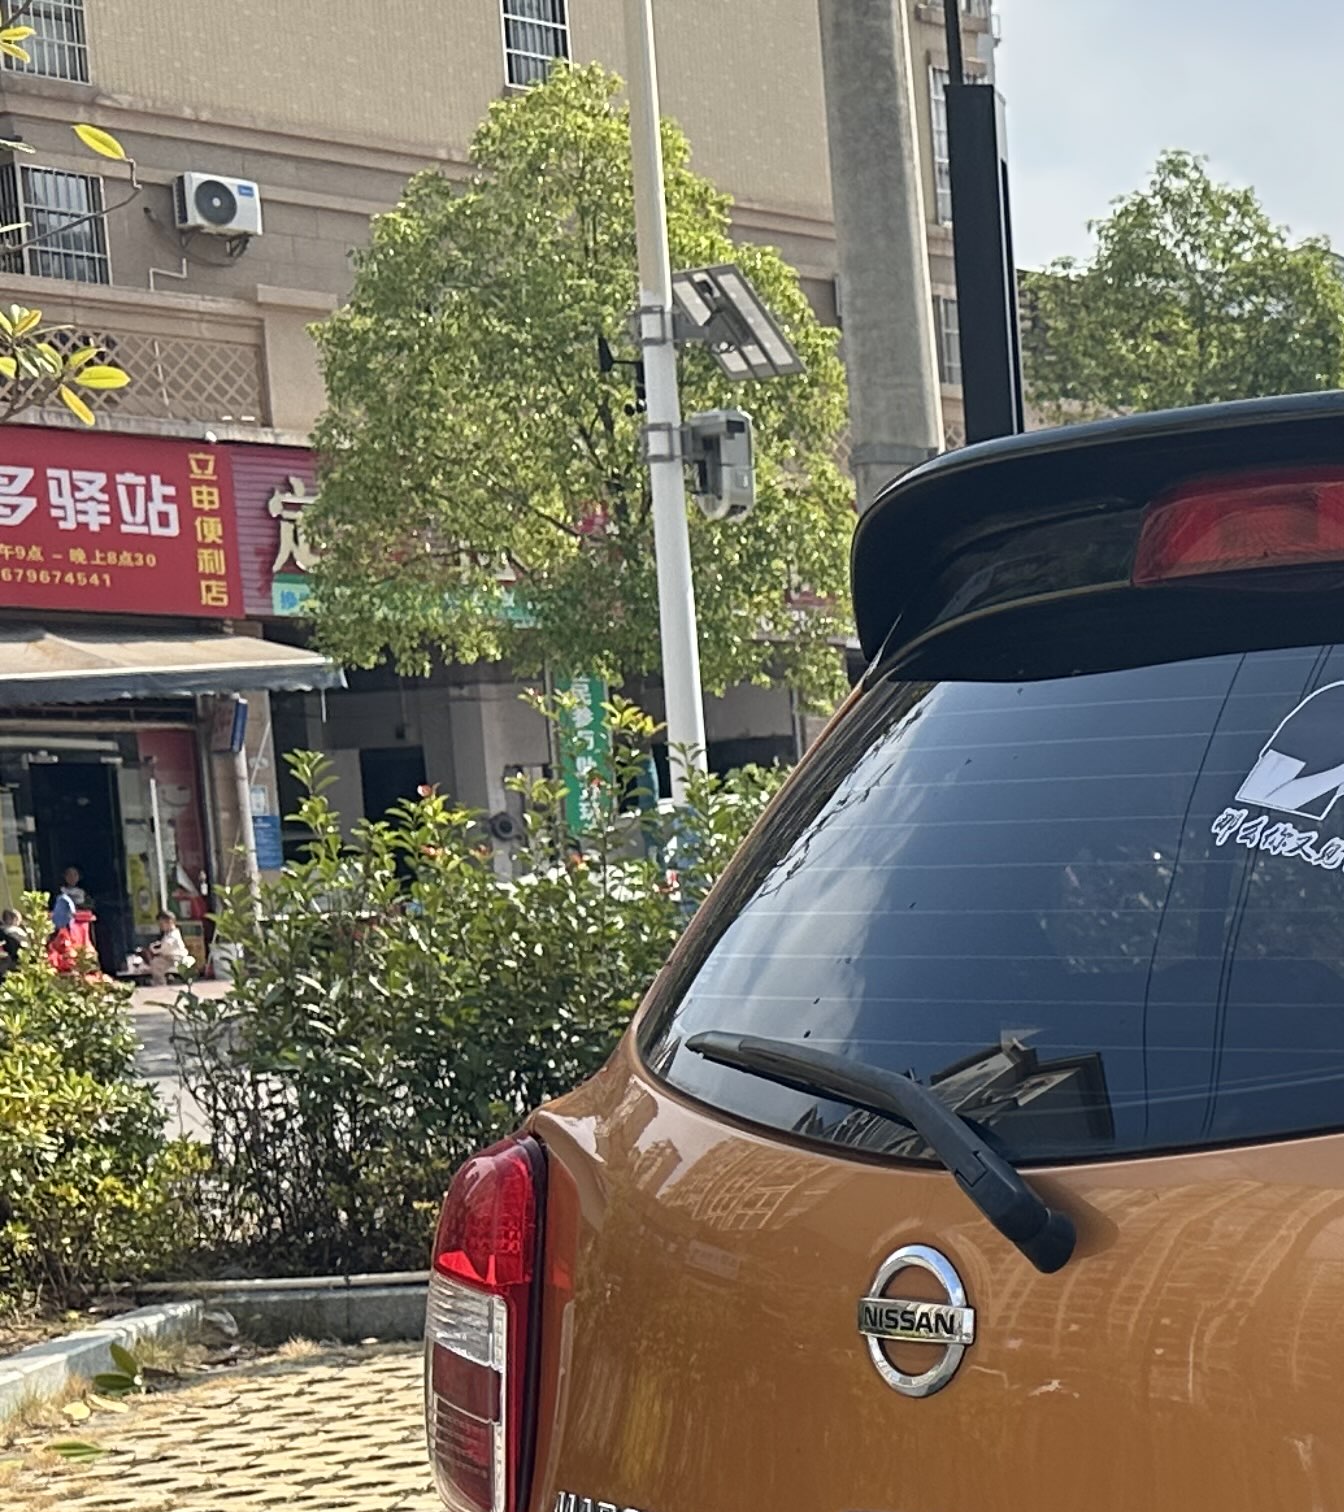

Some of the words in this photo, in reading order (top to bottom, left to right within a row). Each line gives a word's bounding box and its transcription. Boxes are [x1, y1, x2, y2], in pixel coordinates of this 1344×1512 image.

[0, 465, 180, 537] 多驿站
[189, 453, 229, 607] 立申便利店
[864, 1306, 954, 1335] NISSAN
